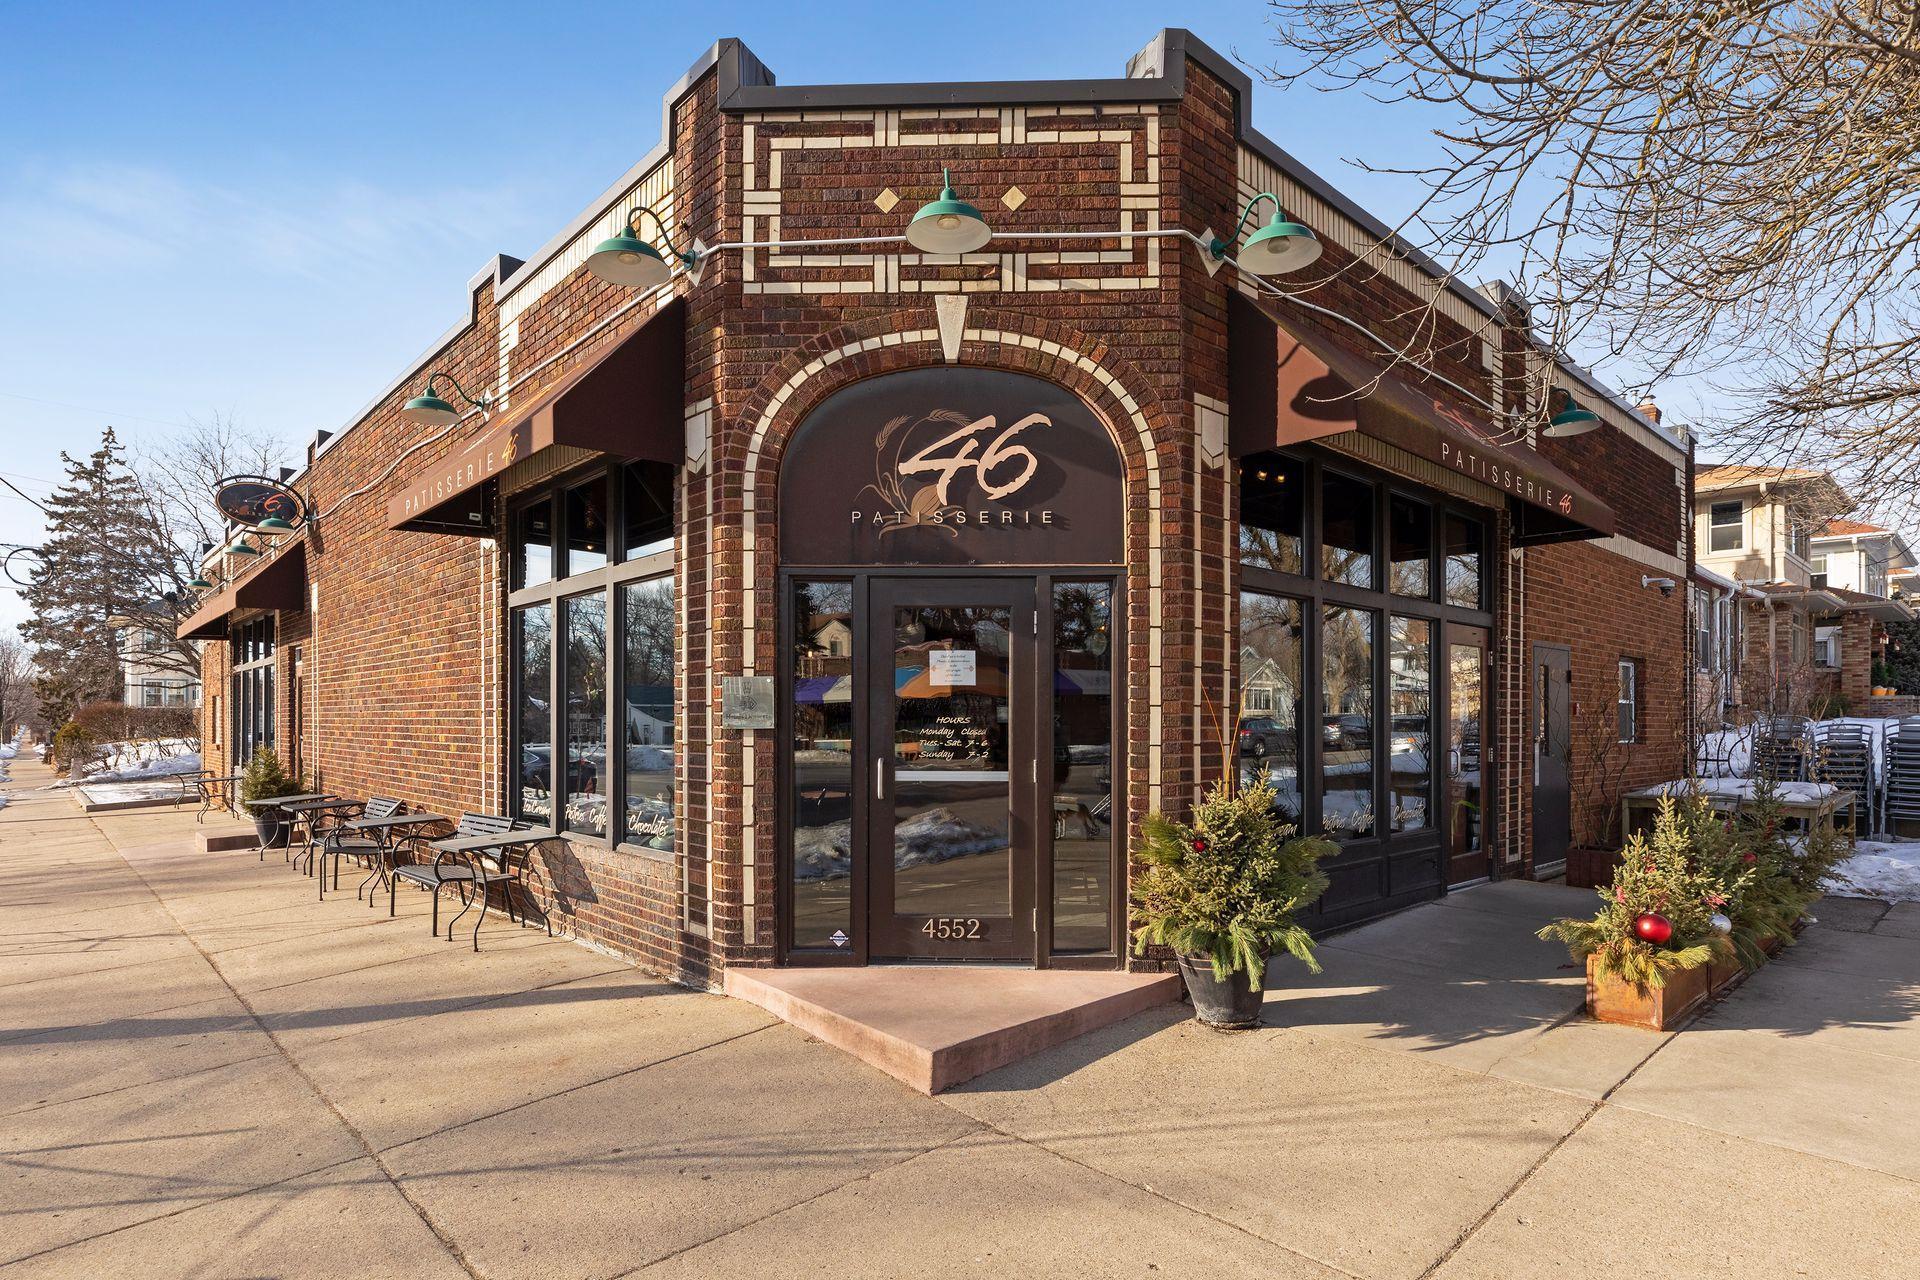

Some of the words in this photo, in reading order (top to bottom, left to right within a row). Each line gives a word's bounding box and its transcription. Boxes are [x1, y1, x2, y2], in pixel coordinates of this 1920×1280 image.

[898, 412, 1052, 506] 46
[405, 452, 494, 515] PATISSERIE
[501, 433, 519, 466] 46
[1442, 442, 1552, 506] PATISSERIE
[1559, 493, 1573, 514] 46
[851, 510, 1053, 524] PATISSERIE
[936, 716, 971, 724] HOURS
[920, 727, 955, 739] Monday
[961, 727, 987, 736] Closed
[919, 750, 954, 762] Sunday
[589, 804, 607, 832] Coffe
[628, 810, 669, 840] Chocolates
[921, 918, 981, 939] 4552
